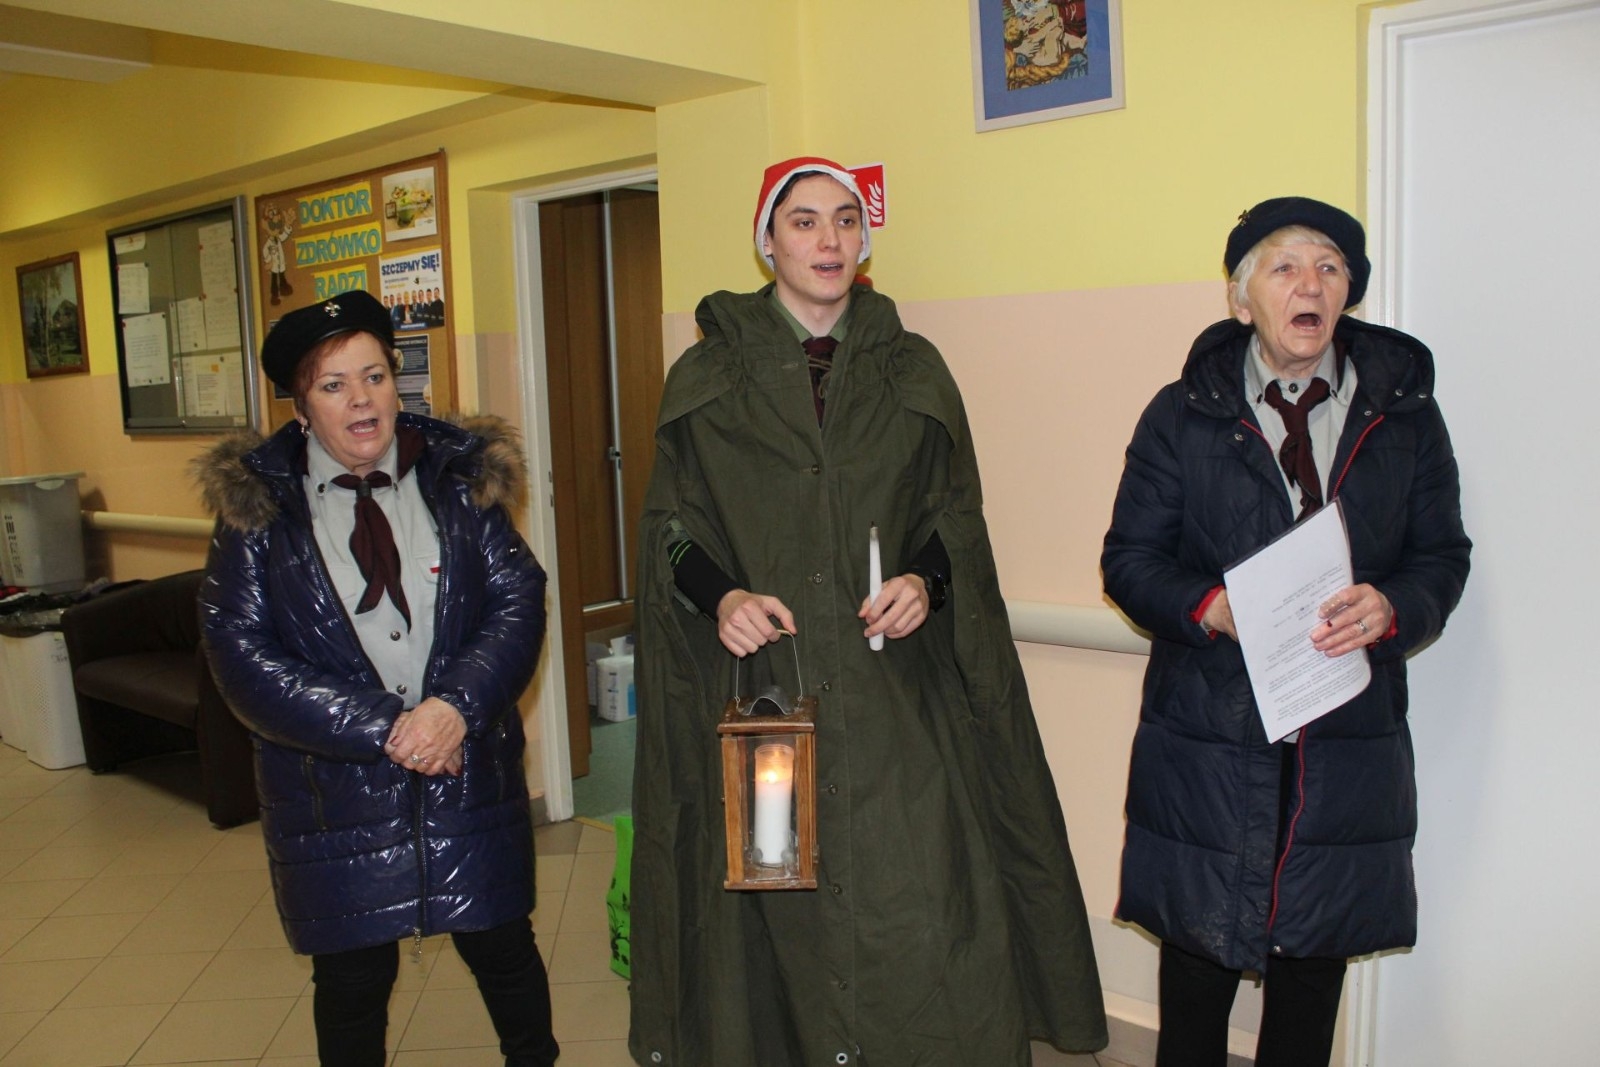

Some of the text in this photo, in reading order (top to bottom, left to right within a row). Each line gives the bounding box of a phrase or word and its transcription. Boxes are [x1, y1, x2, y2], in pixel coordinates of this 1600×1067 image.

[299, 189, 370, 224] DOKTOR
[297, 229, 380, 266] ZDRÓWKO
[381, 252, 440, 276] SZCZEPMY SIĘ!
[314, 269, 367, 301] RADZI
